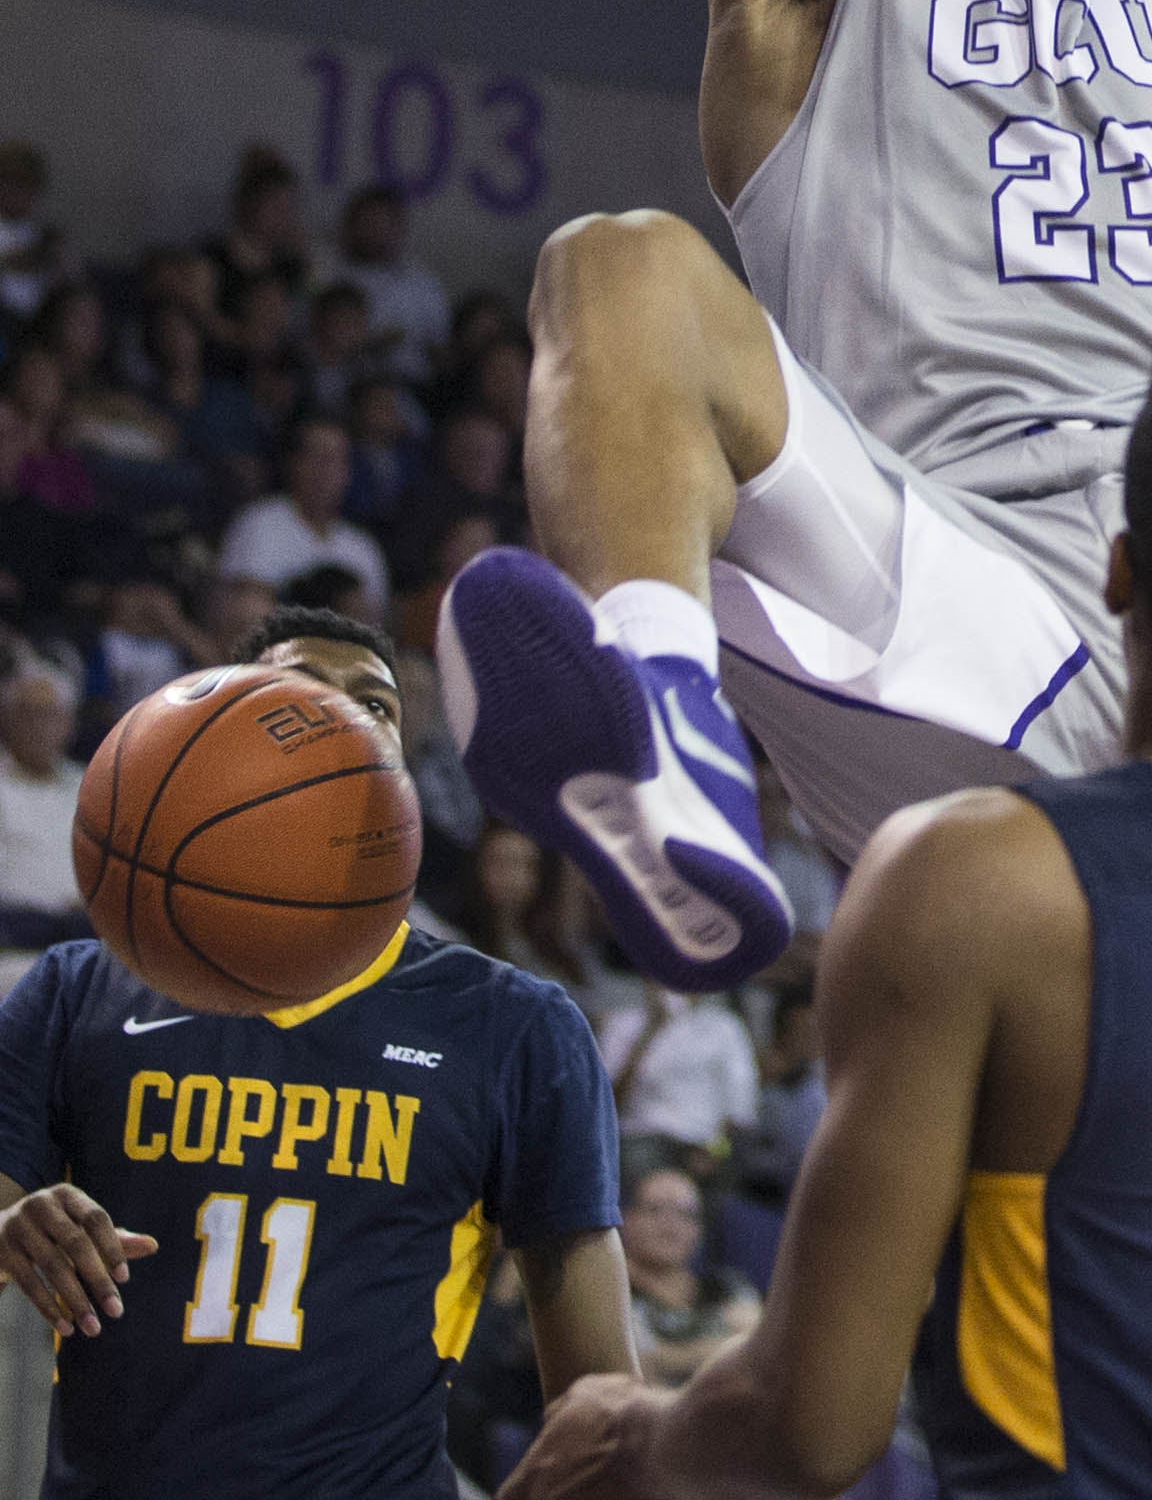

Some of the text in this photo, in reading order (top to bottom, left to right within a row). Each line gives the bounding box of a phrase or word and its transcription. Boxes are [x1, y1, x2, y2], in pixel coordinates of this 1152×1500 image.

[302, 53, 548, 217] 103
[382, 1043, 444, 1068] MEAC
[123, 1069, 421, 1186] COPPIN
[182, 1192, 317, 1351] 11
